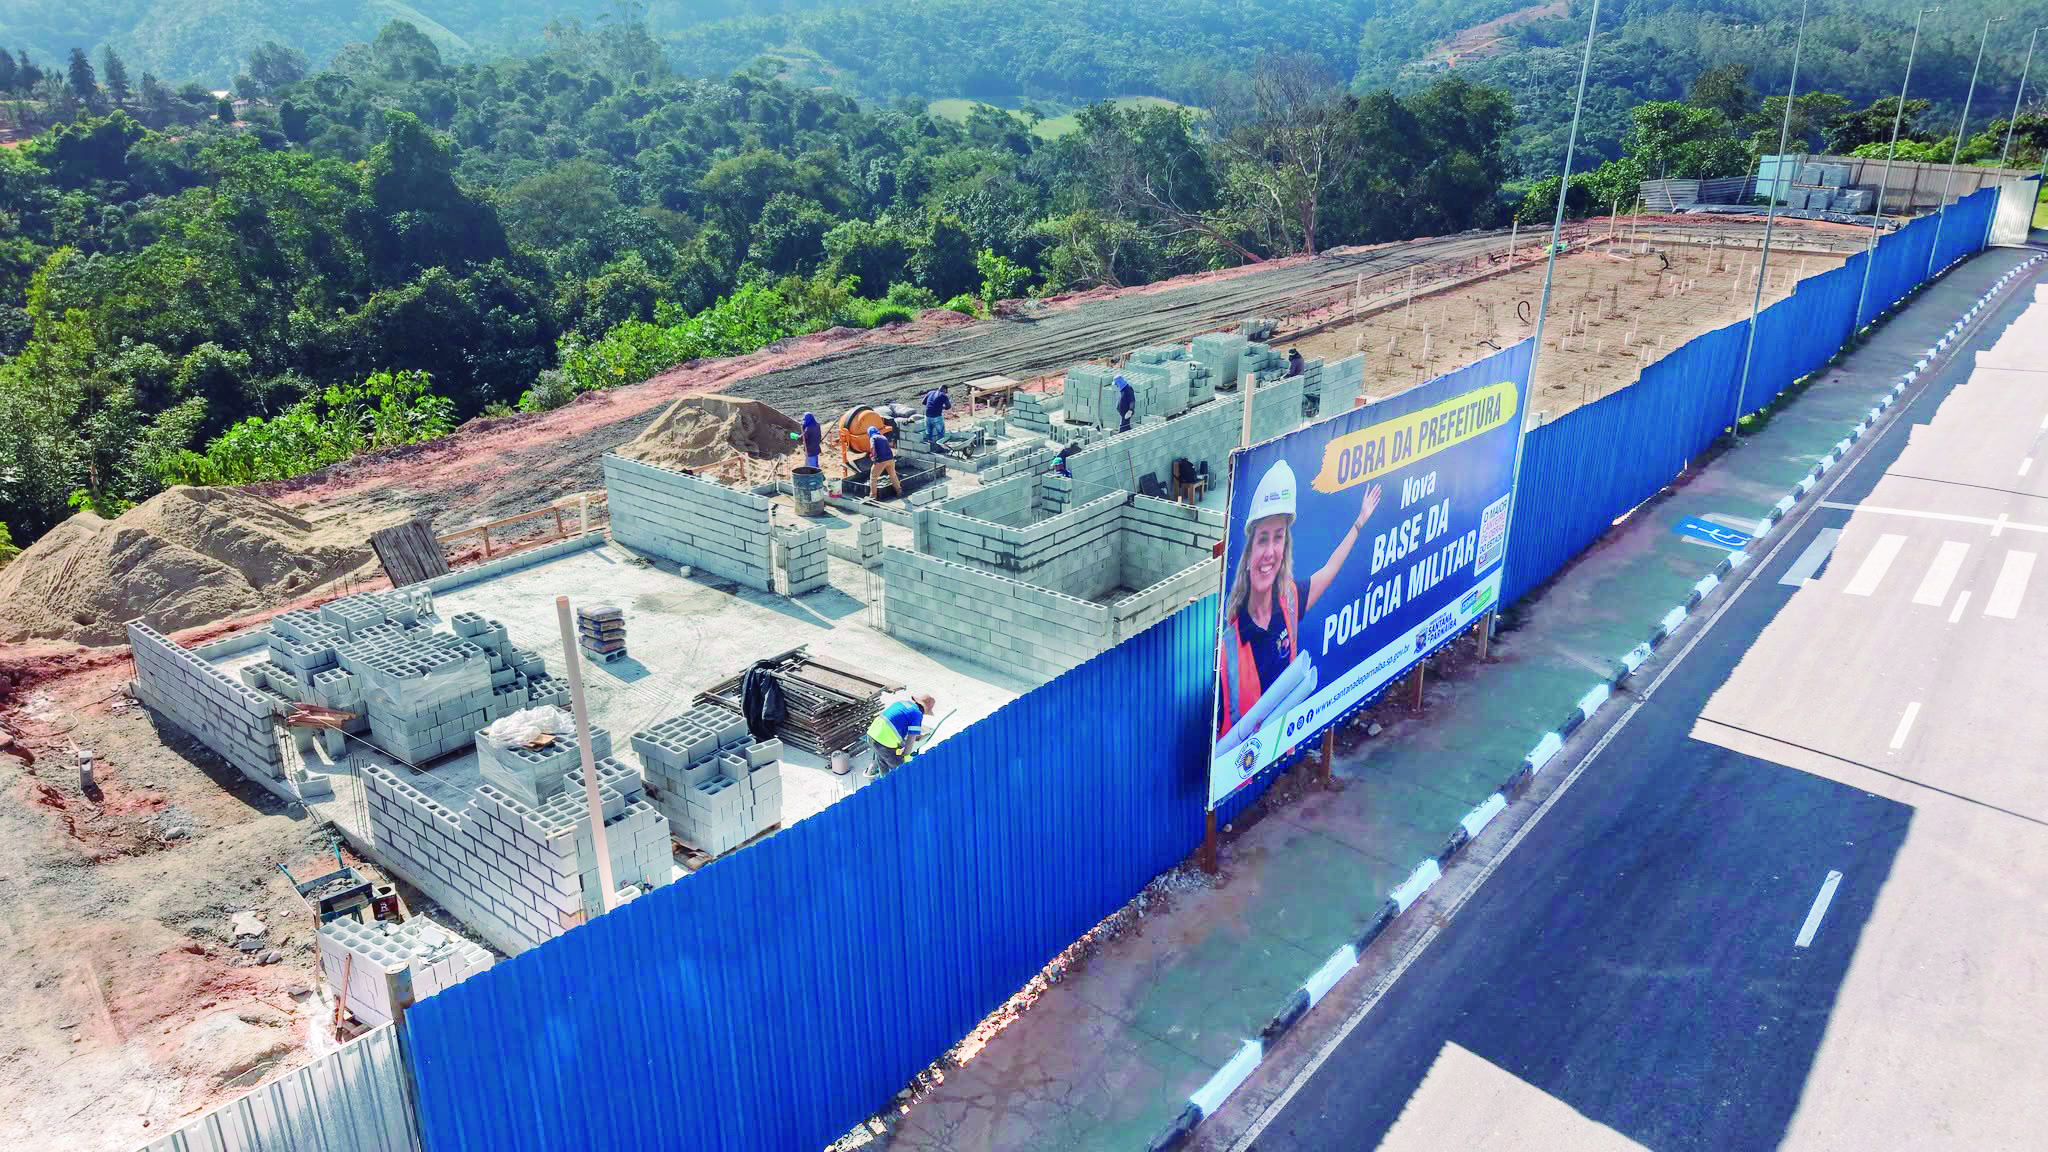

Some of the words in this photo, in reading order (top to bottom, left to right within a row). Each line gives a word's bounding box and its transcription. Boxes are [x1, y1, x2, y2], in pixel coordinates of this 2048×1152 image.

[1338, 436, 1385, 484] OBRA
[1391, 426, 1412, 464] DA
[1417, 392, 1501, 453] PREFEITURA
[1401, 471, 1436, 509] Nova
[1371, 512, 1423, 575] BASE
[1425, 497, 1449, 543] DA
[1322, 574, 1401, 656] POLÍCIA
[1407, 529, 1476, 602] MILITAR
